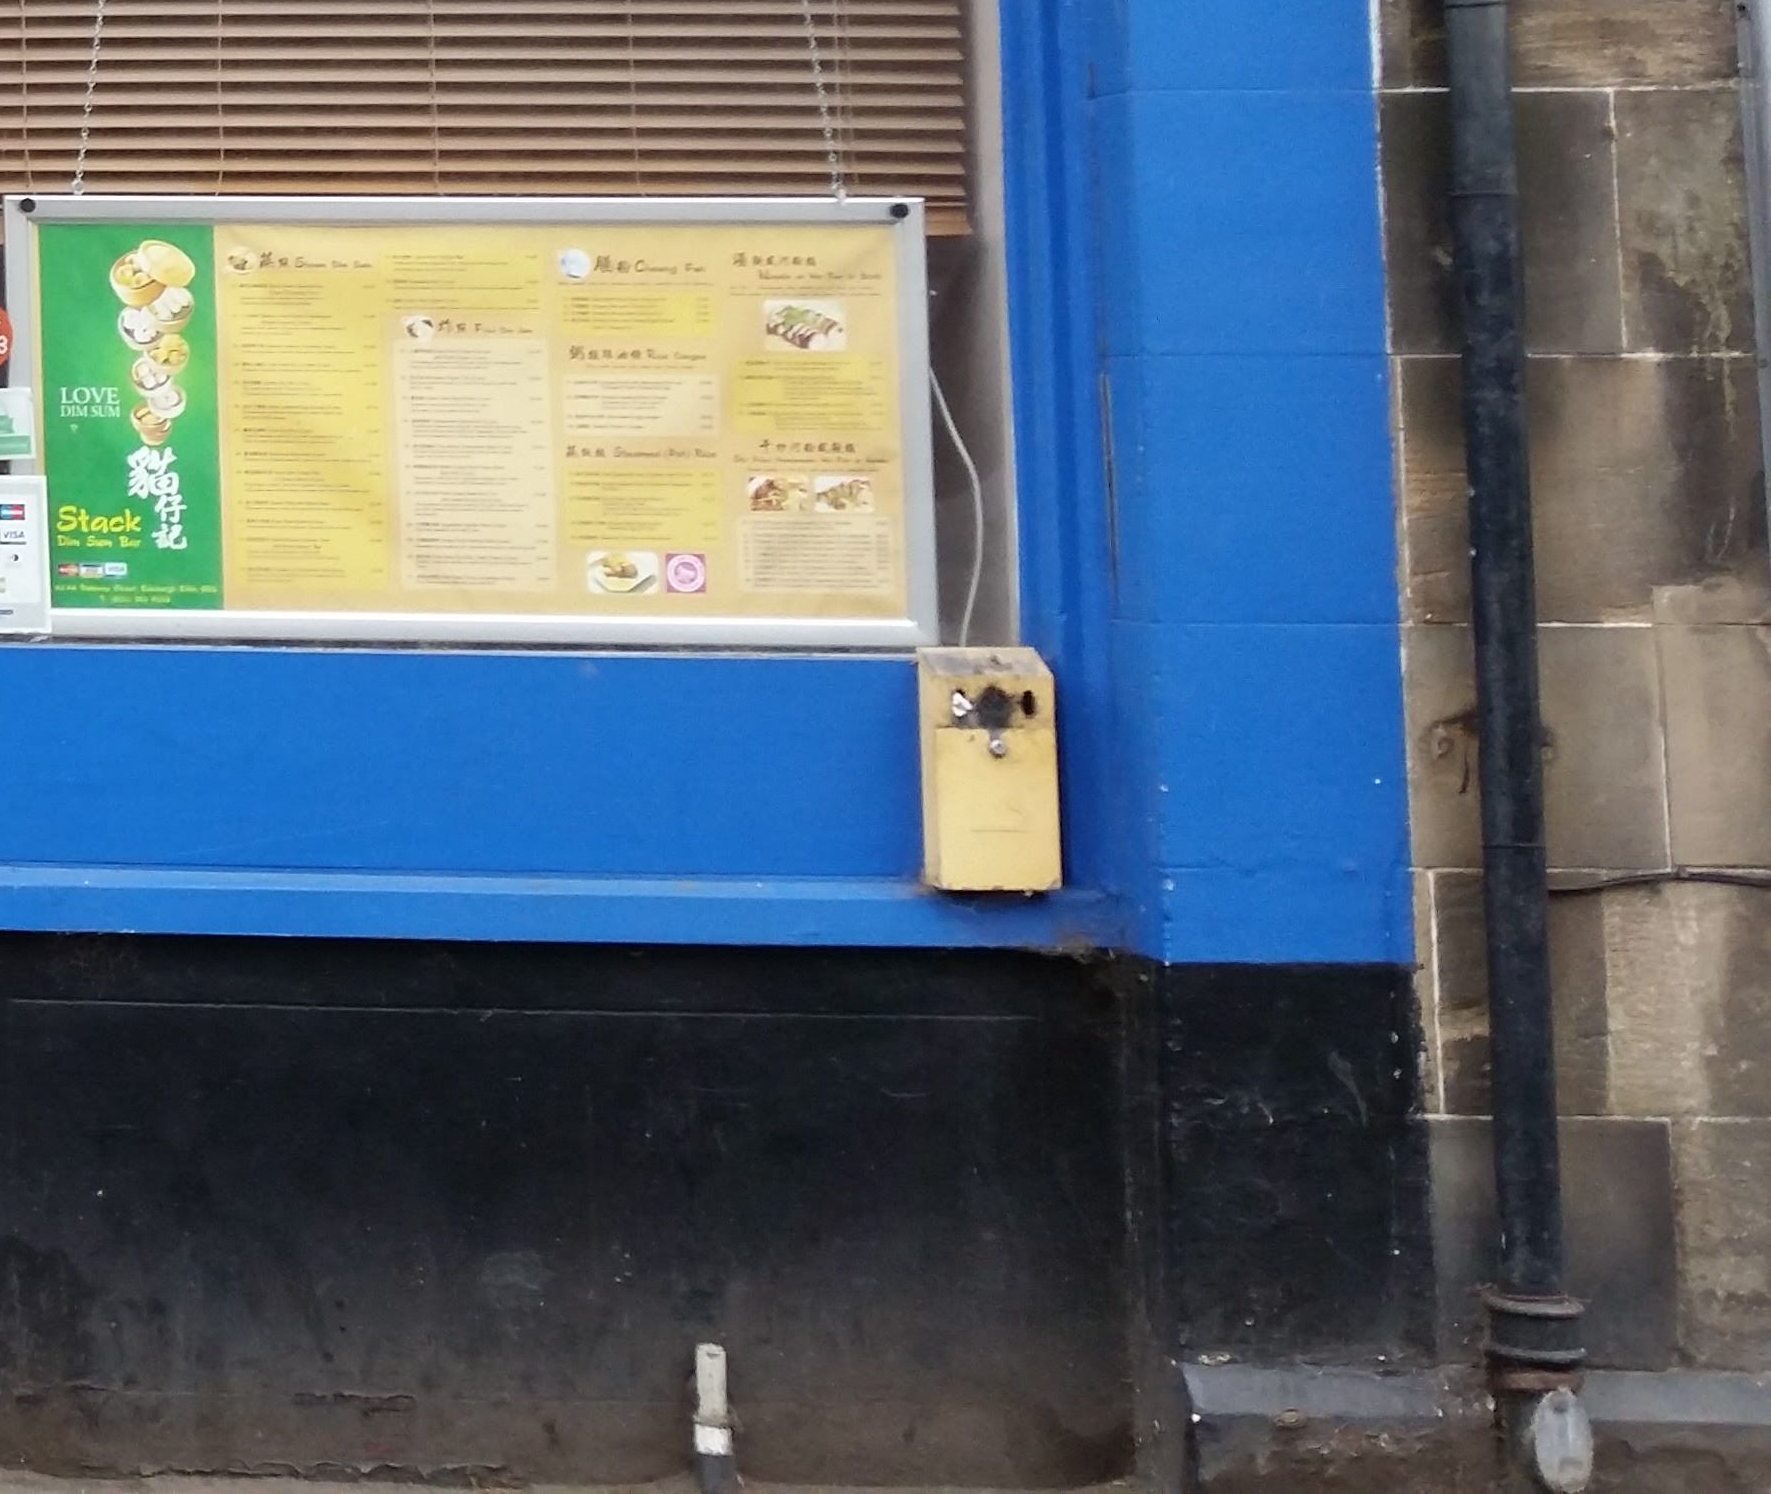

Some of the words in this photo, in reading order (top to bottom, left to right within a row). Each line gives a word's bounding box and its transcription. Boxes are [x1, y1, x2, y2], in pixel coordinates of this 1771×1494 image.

[59, 387, 121, 405] LOVE
[60, 405, 88, 418] DIM
[91, 405, 121, 418] SUM
[56, 505, 142, 533] Stack
[3, 531, 25, 539] VISA
[57, 535, 80, 547] Dim
[86, 535, 112, 548] Sum
[119, 536, 142, 548] Bar
